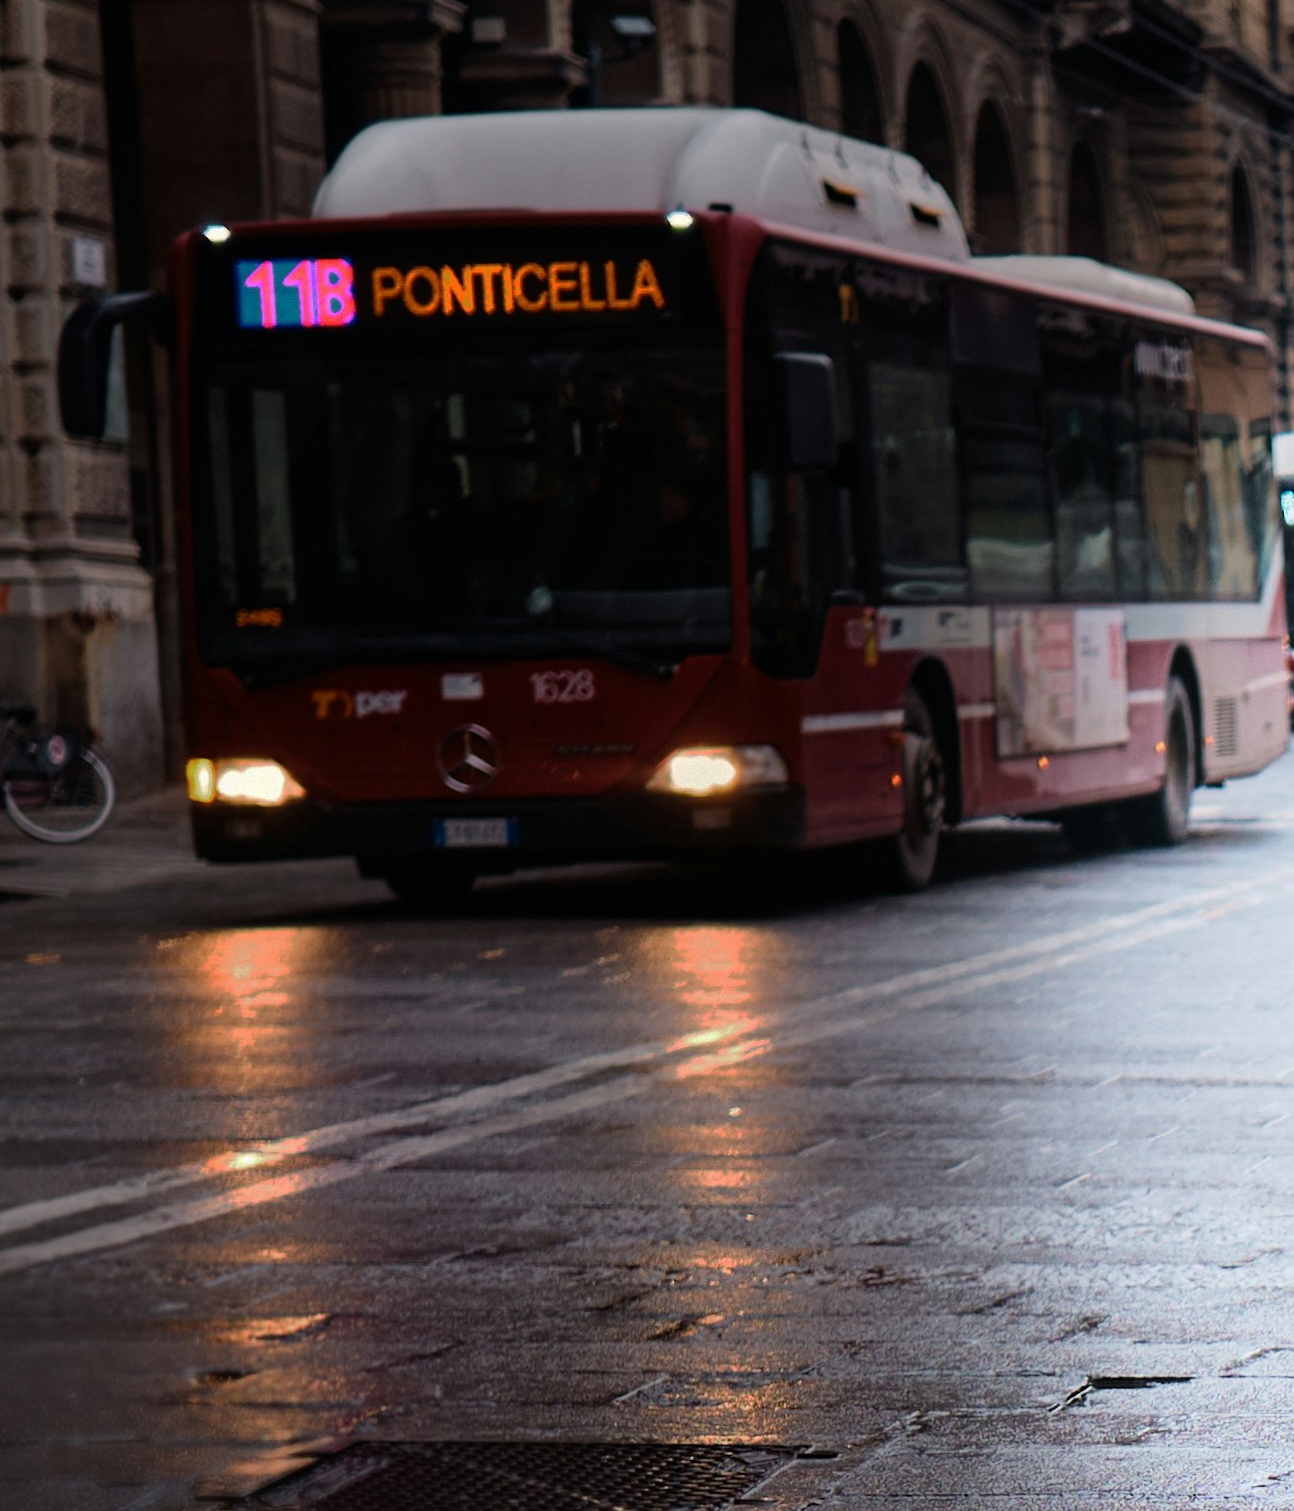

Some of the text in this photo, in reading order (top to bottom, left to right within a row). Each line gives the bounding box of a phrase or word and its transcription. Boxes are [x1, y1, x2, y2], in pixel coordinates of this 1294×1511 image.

[244, 258, 665, 329] 11B PONTICELLA
[529, 668, 596, 705] 1628
